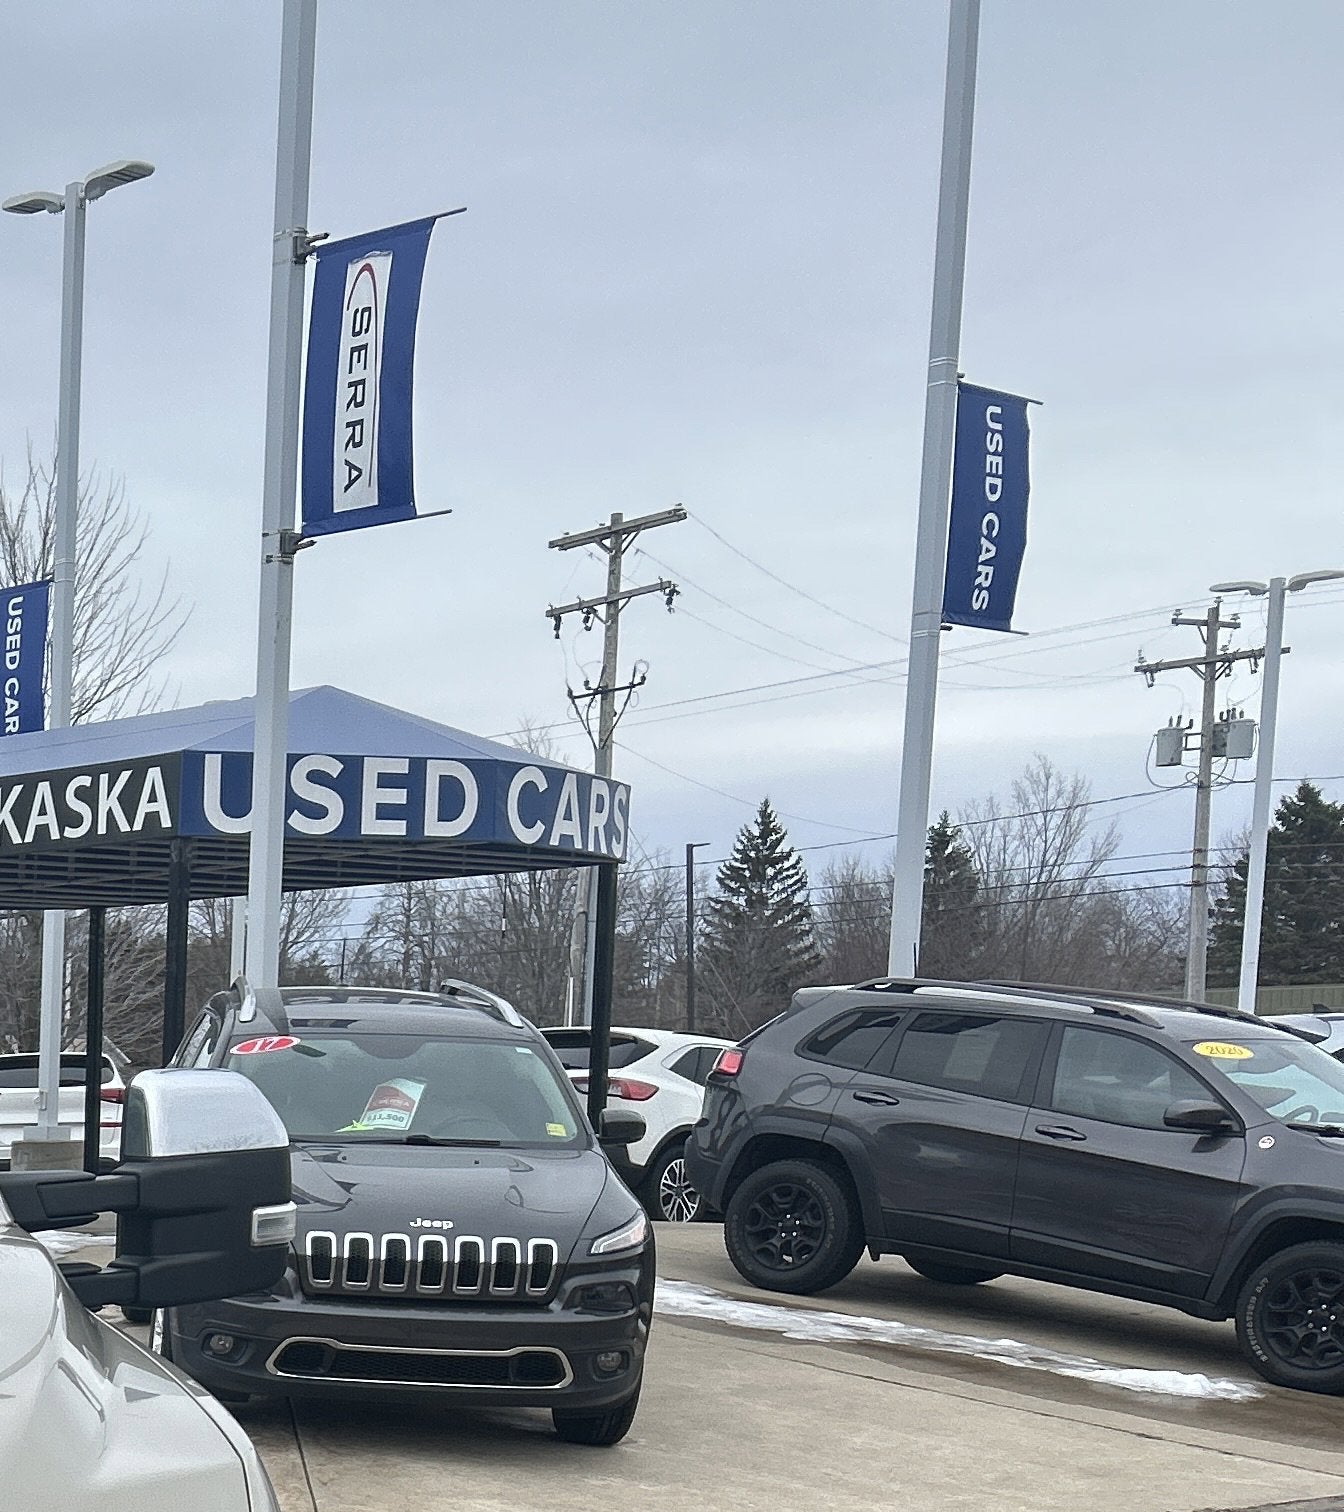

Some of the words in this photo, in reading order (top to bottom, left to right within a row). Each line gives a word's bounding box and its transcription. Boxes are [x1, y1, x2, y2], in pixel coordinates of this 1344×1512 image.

[343, 305, 372, 494] SERRA
[985, 405, 1004, 503] USED
[972, 511, 1001, 611] CARS
[5, 595, 24, 670] USED
[4, 677, 20, 735] CAR
[203, 753, 479, 837] USED
[506, 764, 628, 859] CARS
[409, 1217, 454, 1230] Jeep
